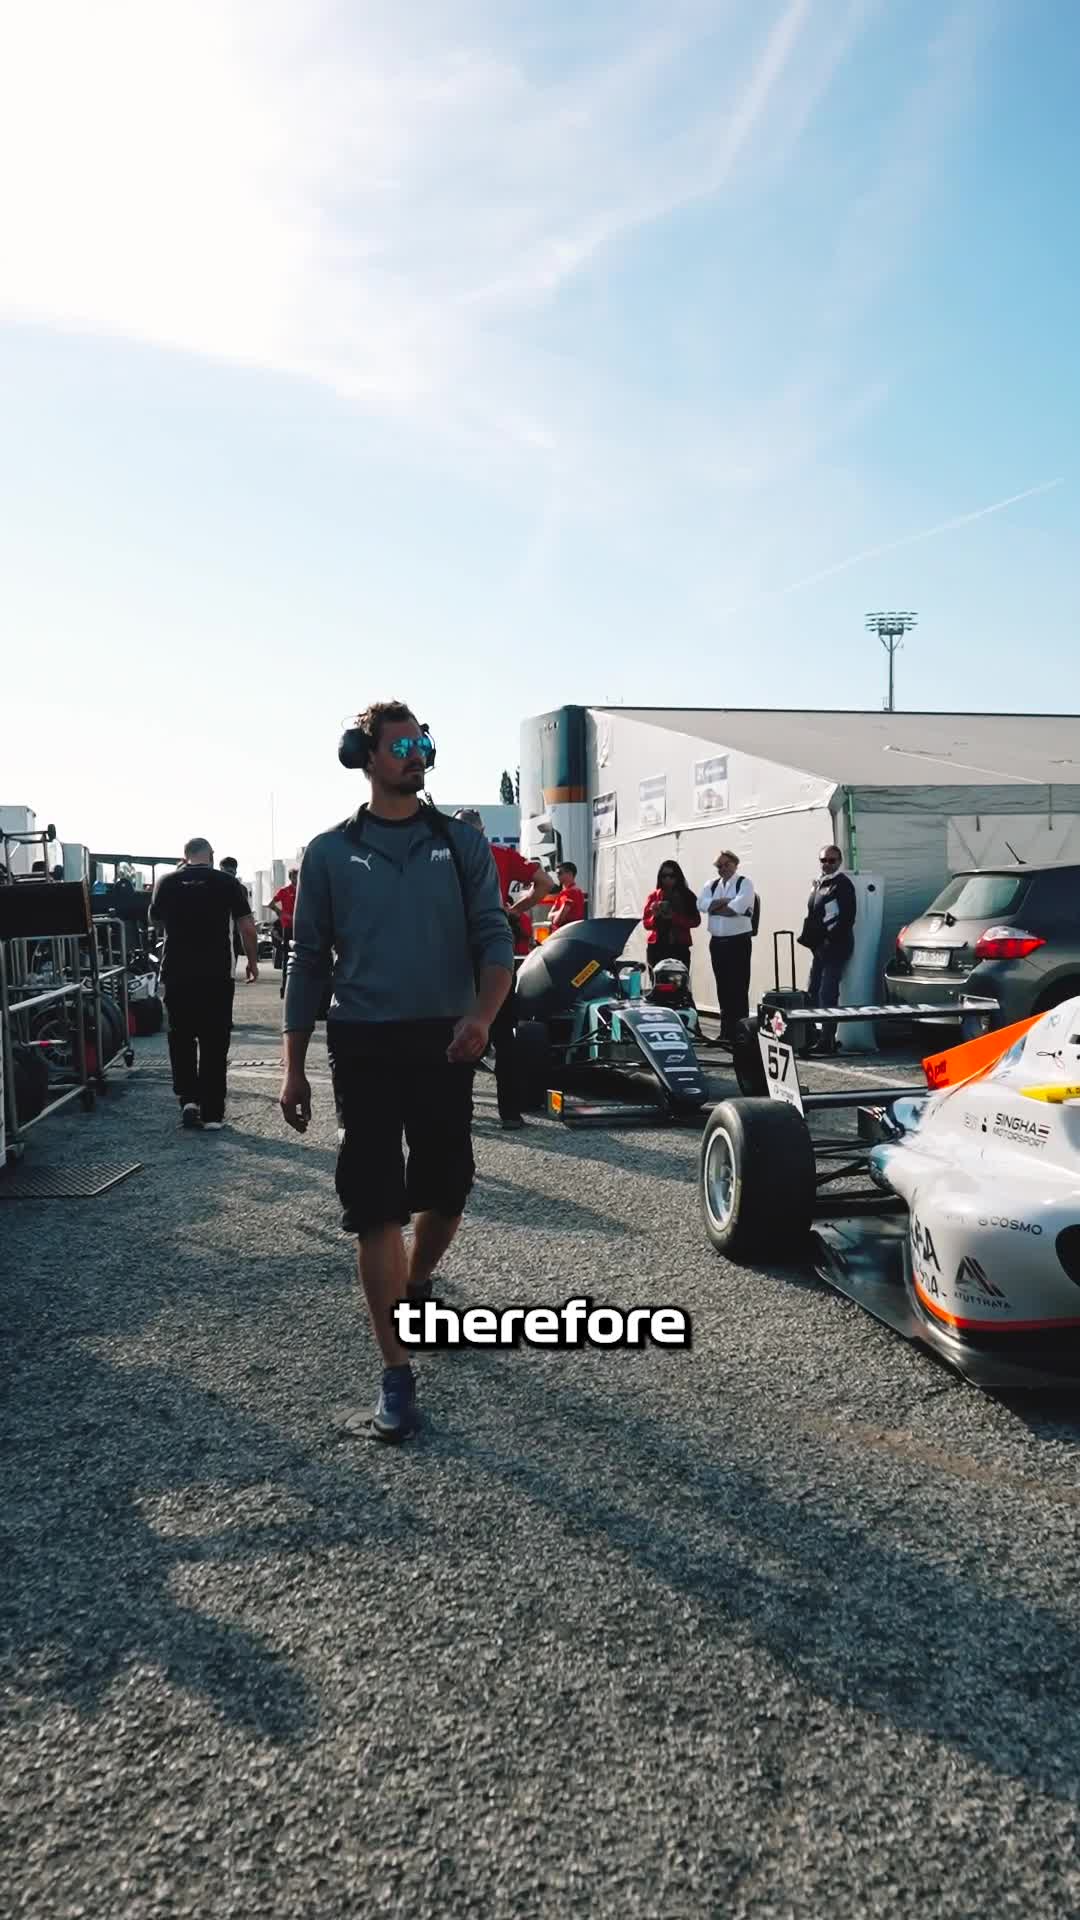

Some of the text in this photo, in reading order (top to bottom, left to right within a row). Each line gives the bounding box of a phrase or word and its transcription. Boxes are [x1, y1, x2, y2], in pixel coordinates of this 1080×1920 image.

[649, 1031, 681, 1042] 14
[767, 1044, 790, 1083] 57
[995, 1112, 1037, 1135] SINGHA
[992, 1127, 1047, 1151] MOTORSPORT
[990, 1215, 1043, 1236] COSMO
